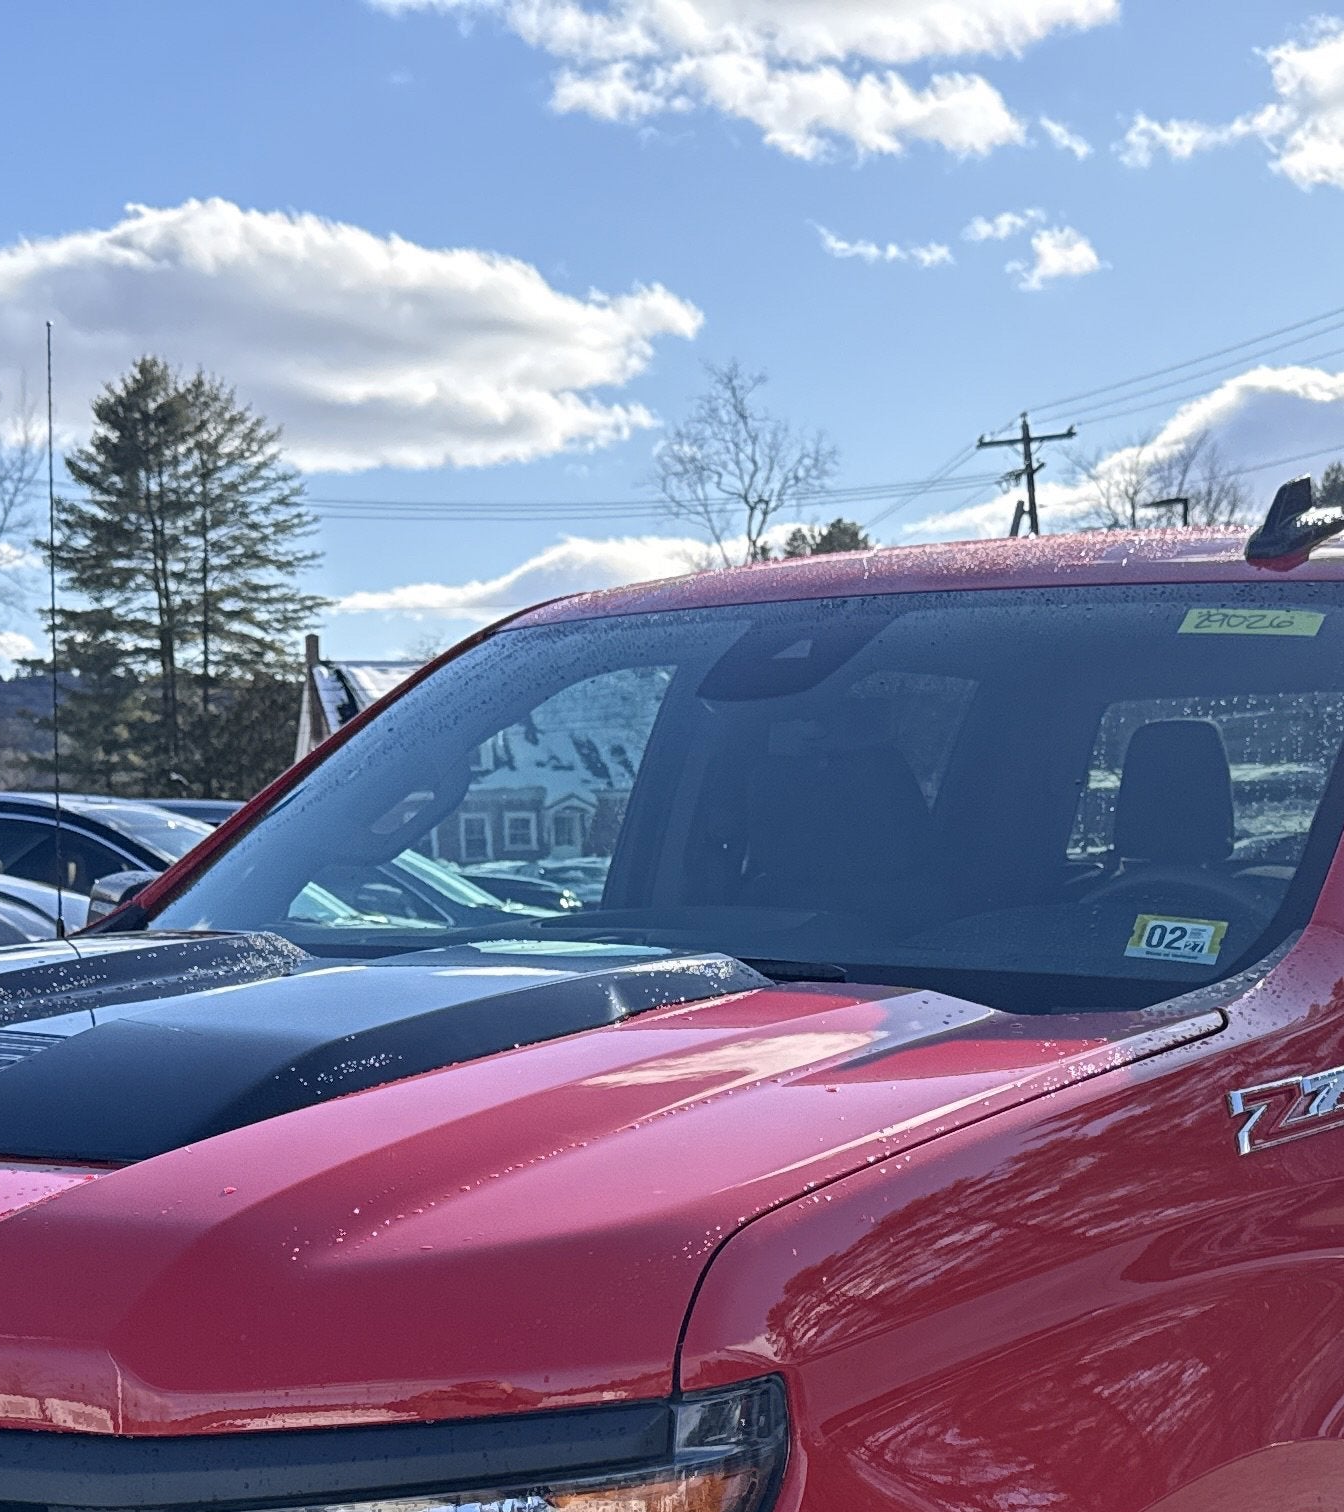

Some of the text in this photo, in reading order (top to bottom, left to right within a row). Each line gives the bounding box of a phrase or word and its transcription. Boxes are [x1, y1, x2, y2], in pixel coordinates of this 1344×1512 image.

[1194, 611, 1295, 630] 29026
[1145, 924, 1188, 951] 02
[1184, 941, 1205, 954] 27
